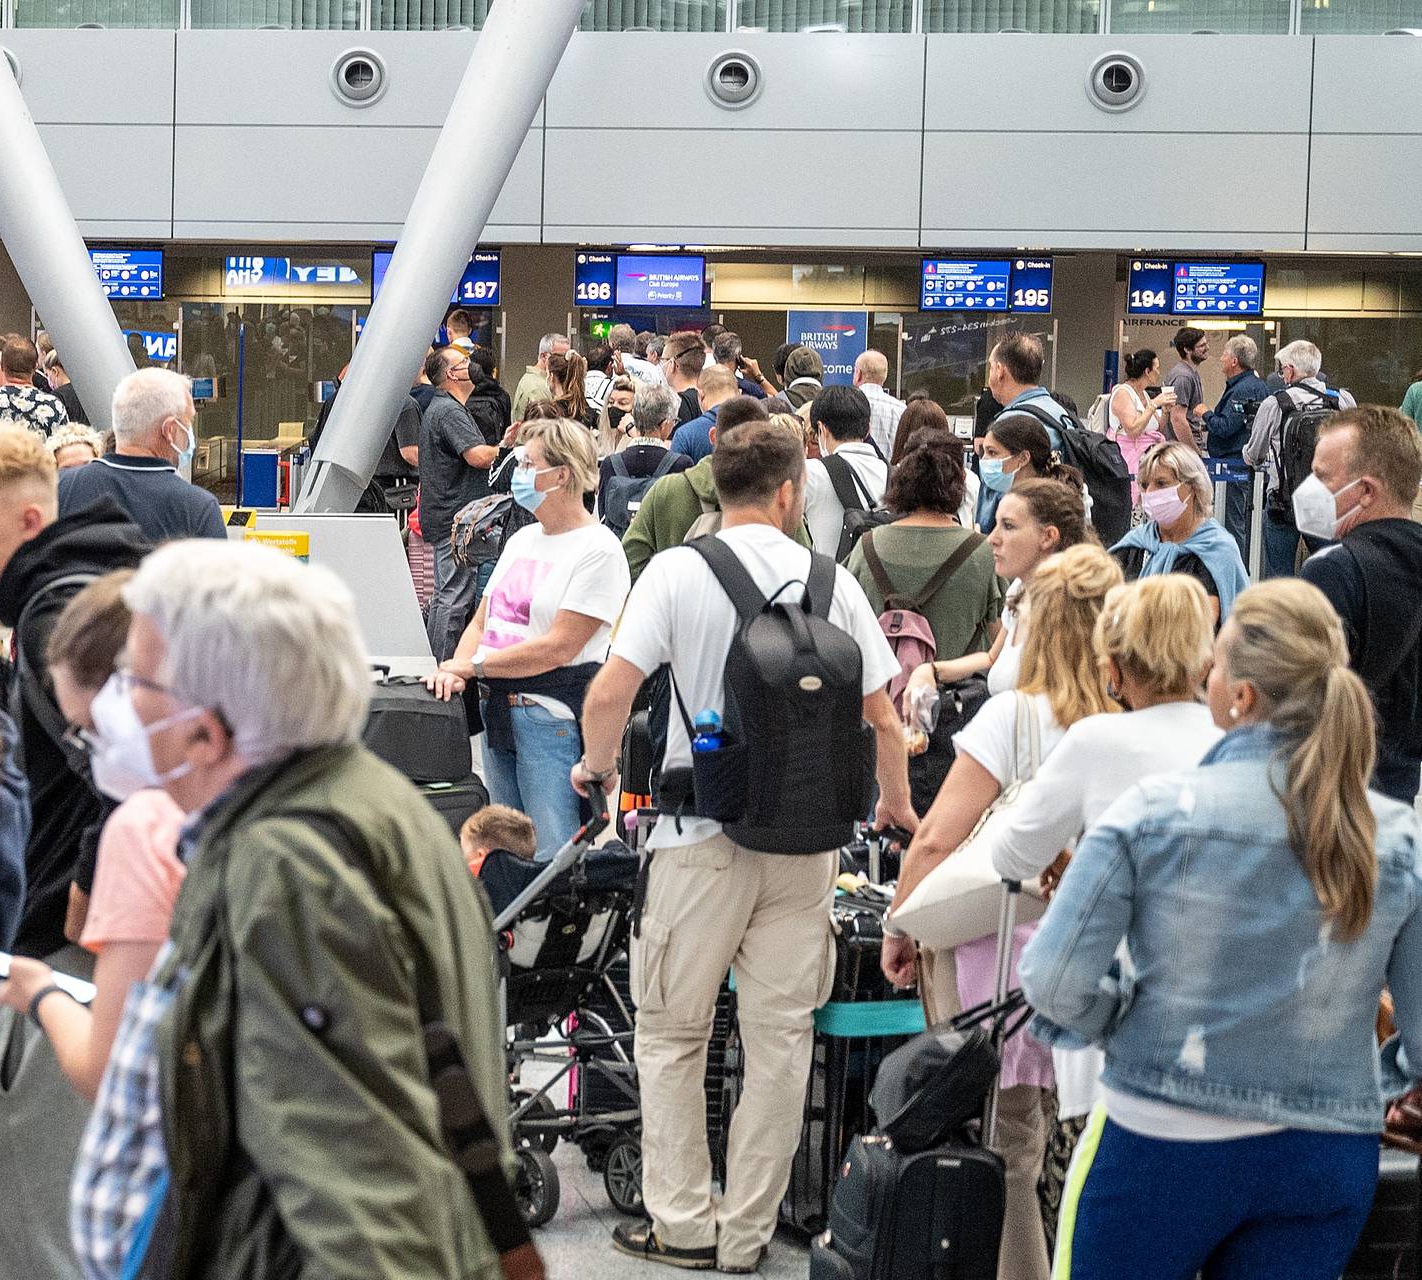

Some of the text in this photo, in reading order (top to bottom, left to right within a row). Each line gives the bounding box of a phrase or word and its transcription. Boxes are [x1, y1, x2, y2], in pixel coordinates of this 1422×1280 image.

[464, 281, 498, 298] 197
[577, 282, 611, 300] 196
[1014, 289, 1049, 306] 195
[1131, 290, 1166, 307] 194
[800, 332, 838, 341] BRITISH
[800, 341, 838, 350] AIRWAYS
[822, 364, 853, 374] come
